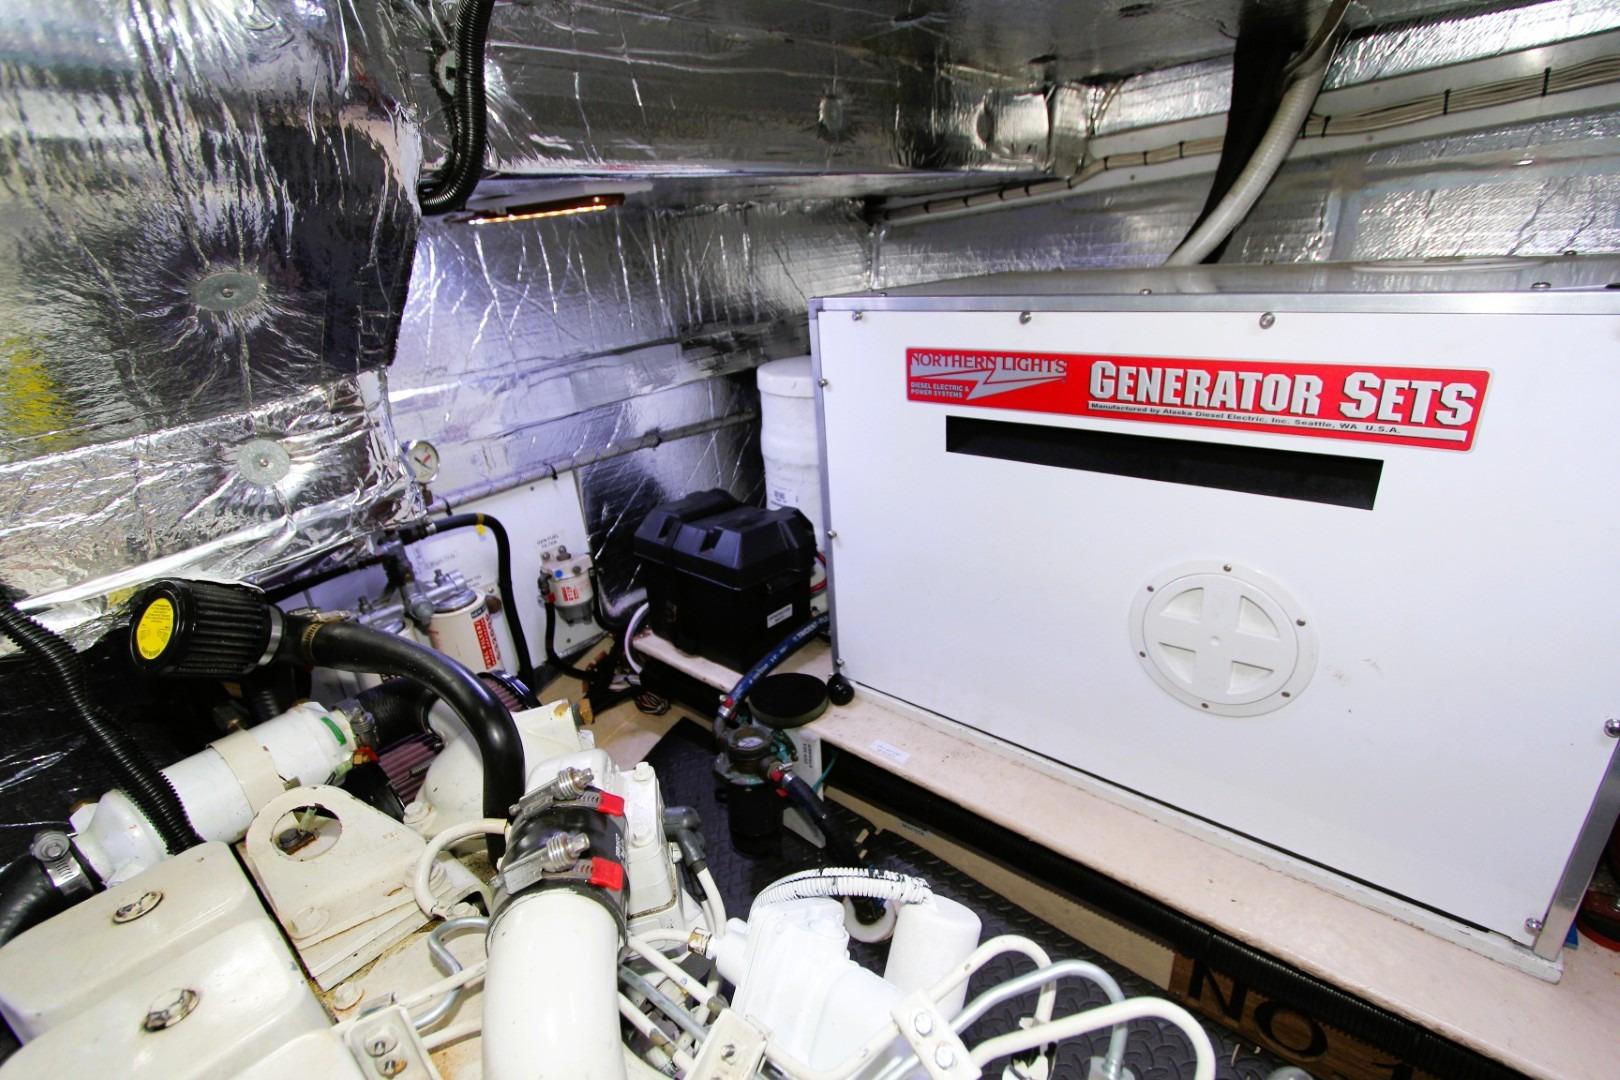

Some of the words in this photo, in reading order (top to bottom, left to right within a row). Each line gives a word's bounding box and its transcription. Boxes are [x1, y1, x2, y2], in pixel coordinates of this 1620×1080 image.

[911, 353, 997, 369] NORTHERN
[1001, 356, 1067, 374] LIGHTS
[933, 383, 963, 391] ELECTRIC
[933, 390, 963, 398] SYSTEMS
[1089, 360, 1324, 416] GENERATOR
[1339, 371, 1477, 427] SETS
[1091, 402, 1148, 412] Manufactured
[1163, 408, 1192, 416] Alaska
[1195, 411, 1224, 419] Diesel
[1227, 413, 1268, 423] Electric,
[1271, 417, 1290, 425] Inc.
[1294, 419, 1336, 429] Seattle,
[1365, 424, 1401, 433] U.S.A.
